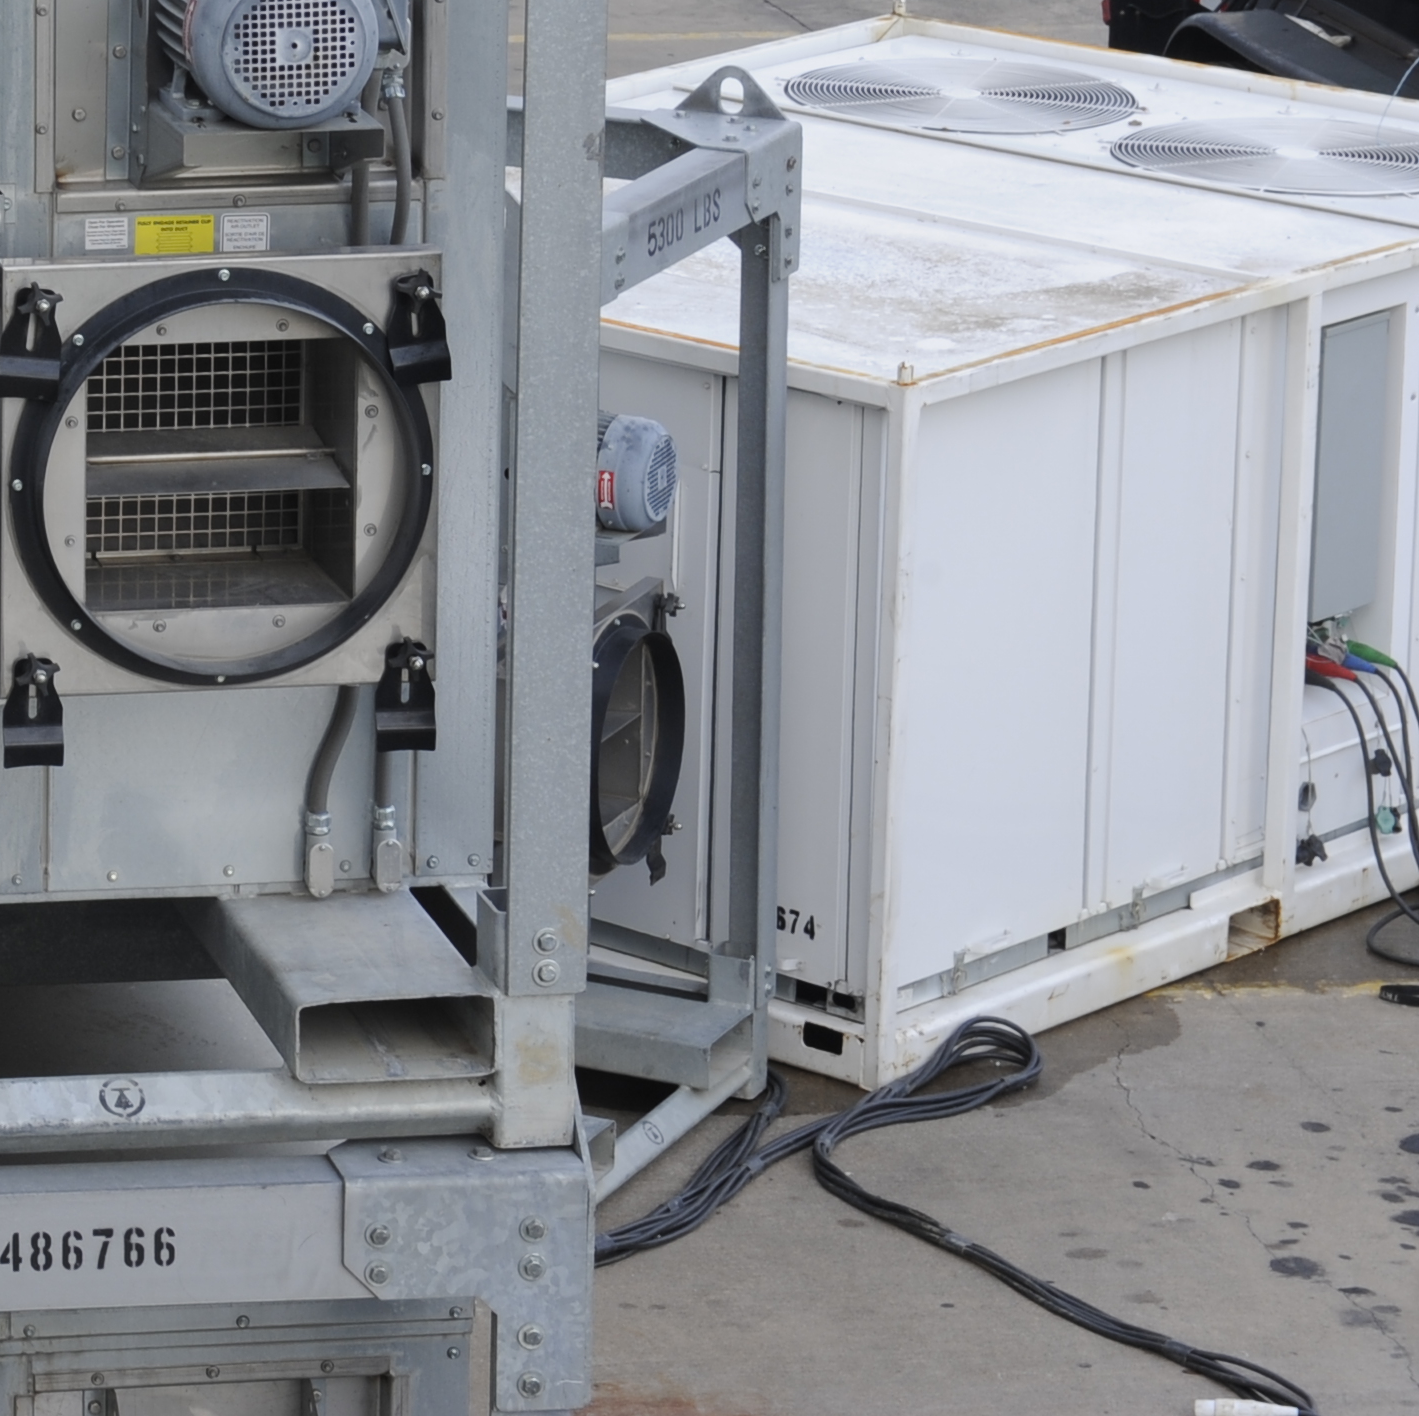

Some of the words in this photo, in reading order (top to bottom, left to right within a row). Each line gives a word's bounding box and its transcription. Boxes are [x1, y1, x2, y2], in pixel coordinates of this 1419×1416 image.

[648, 207, 683, 257] 5300
[694, 188, 721, 234] LBS
[0, 1227, 176, 1272] 486766
